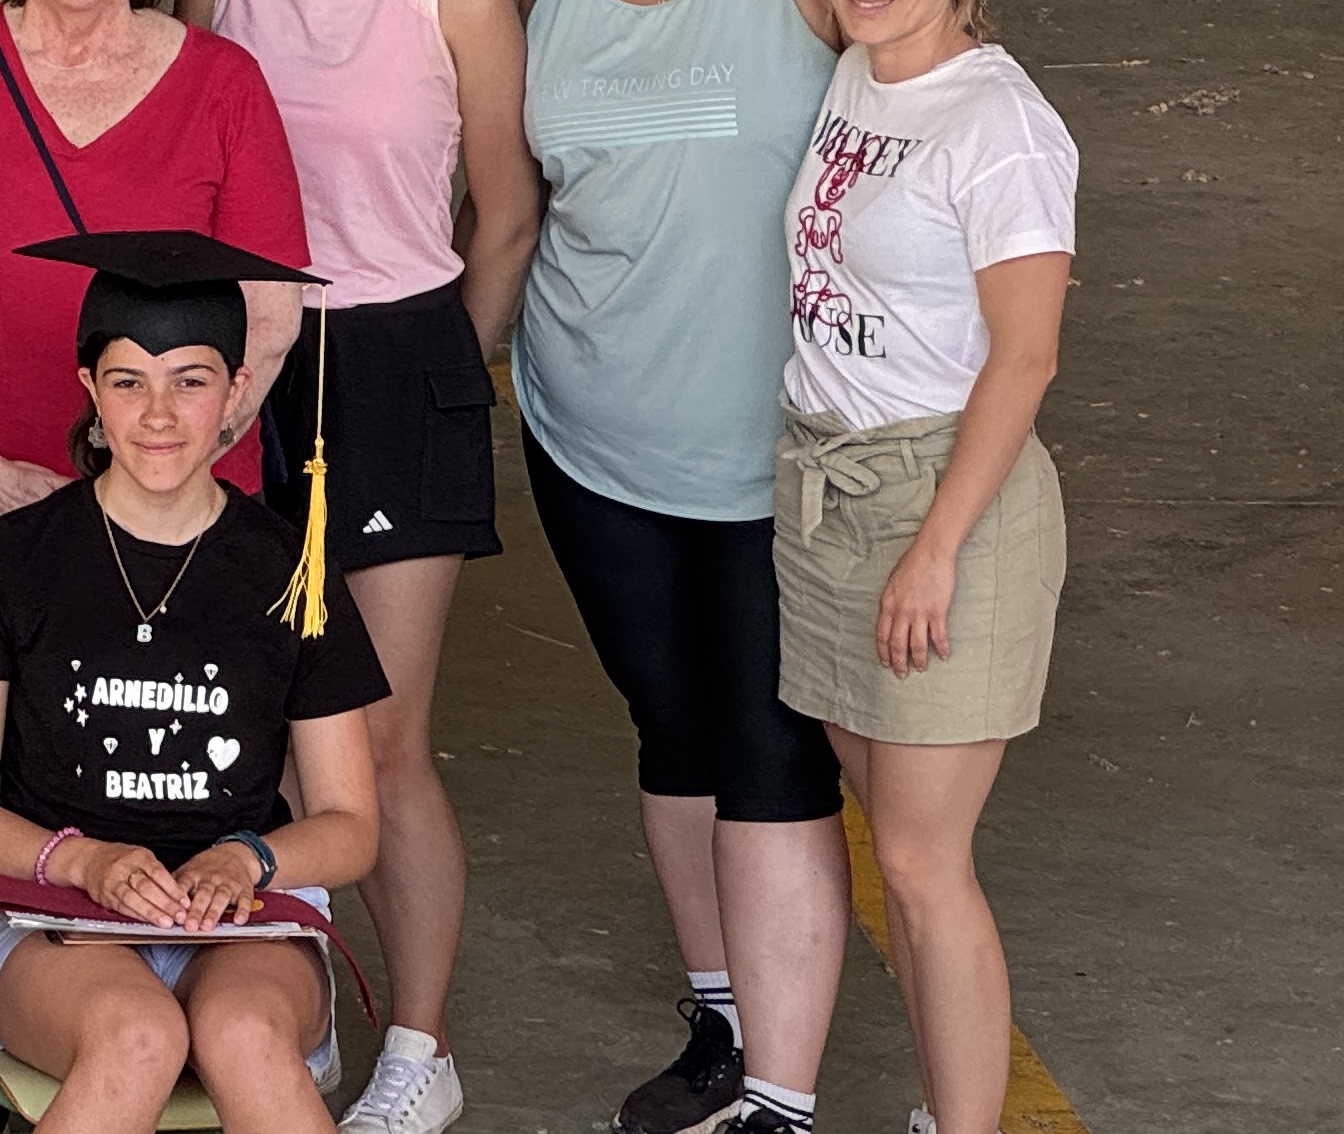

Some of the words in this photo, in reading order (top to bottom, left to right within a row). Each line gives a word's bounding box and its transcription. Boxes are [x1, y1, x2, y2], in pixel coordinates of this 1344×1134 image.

[580, 69, 681, 97] TRAINING
[690, 63, 734, 86] DAY
[137, 624, 153, 642] B
[148, 728, 166, 755] Y
